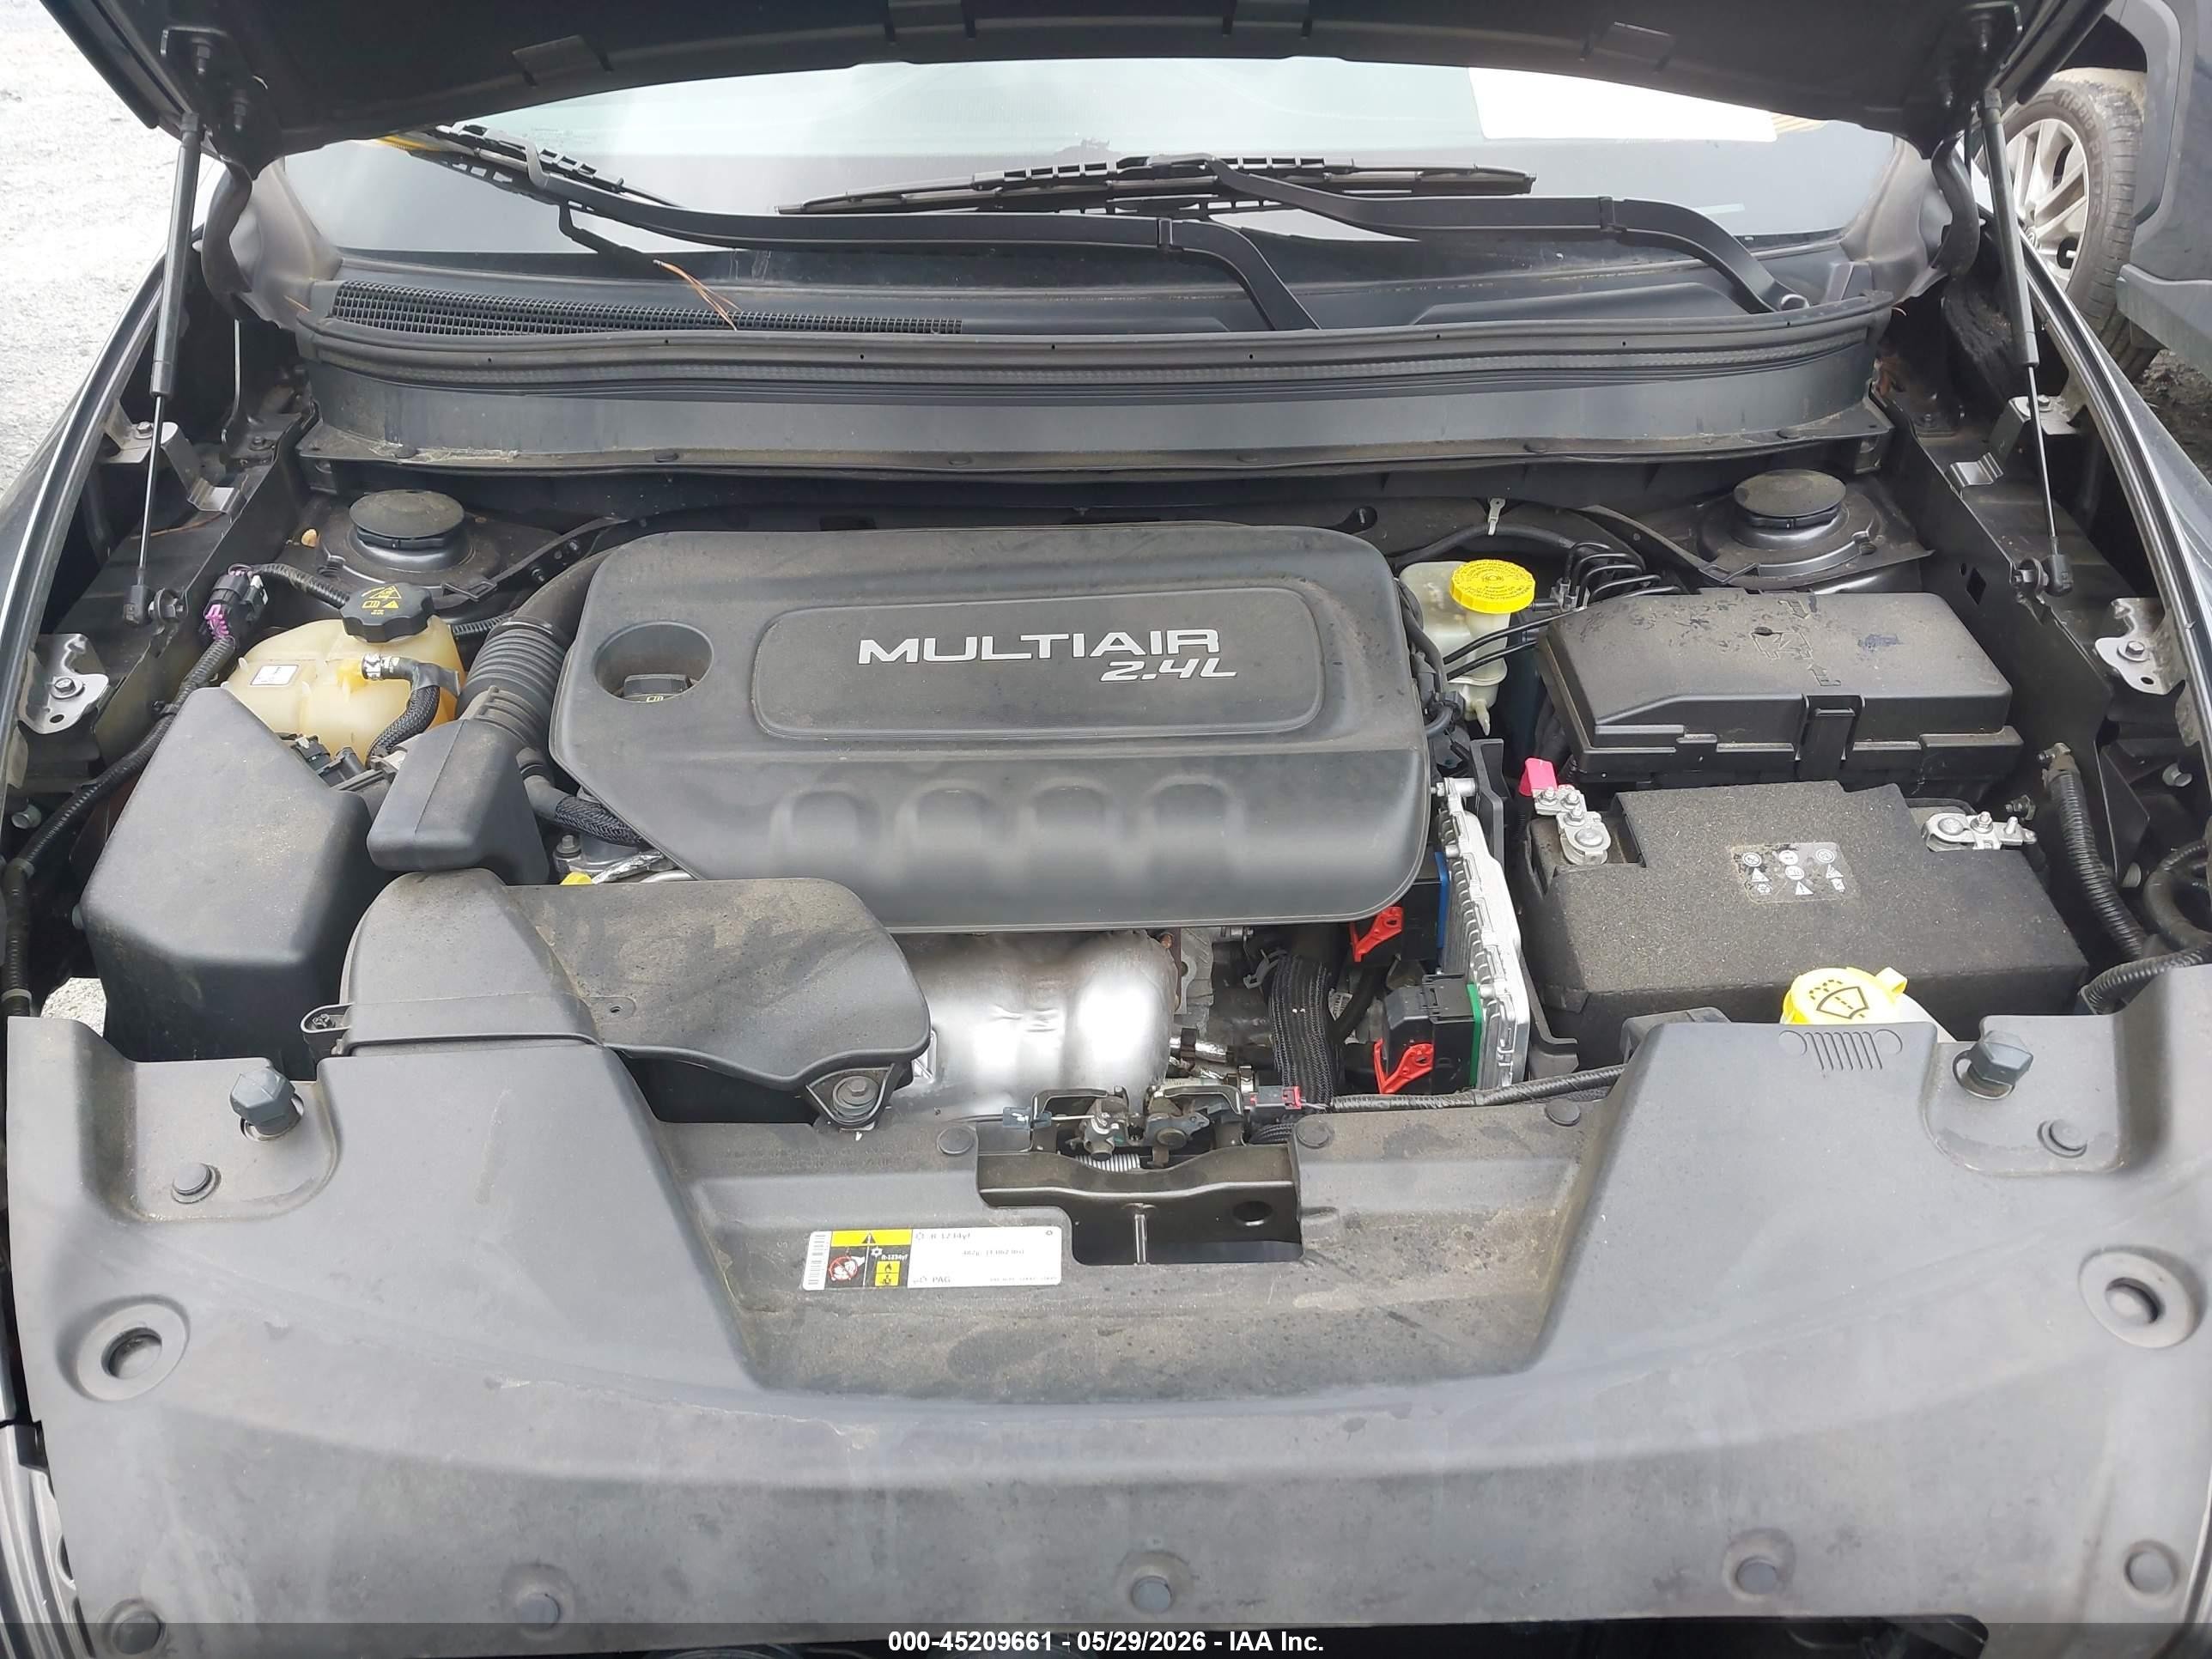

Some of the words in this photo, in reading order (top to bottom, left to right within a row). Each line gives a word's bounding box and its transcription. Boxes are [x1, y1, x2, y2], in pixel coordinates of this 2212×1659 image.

[859, 629, 1220, 665] MULTIAIR
[1100, 657, 1237, 682] 2.4L
[932, 1275, 951, 1284] PAG
